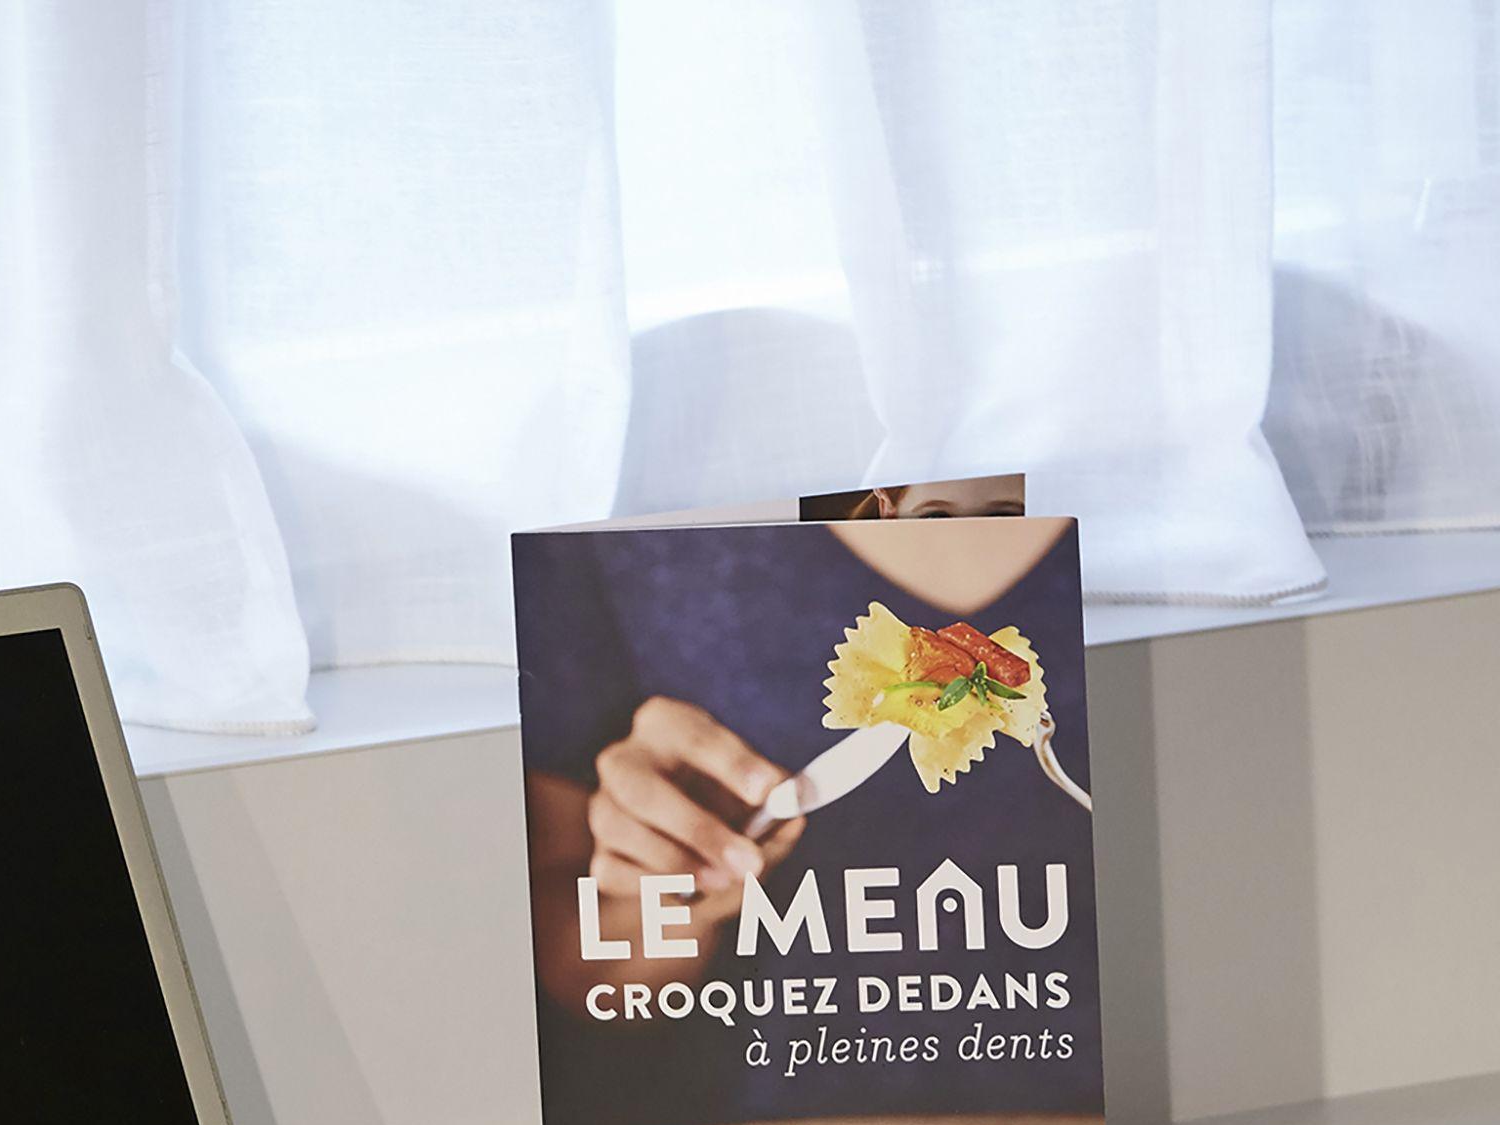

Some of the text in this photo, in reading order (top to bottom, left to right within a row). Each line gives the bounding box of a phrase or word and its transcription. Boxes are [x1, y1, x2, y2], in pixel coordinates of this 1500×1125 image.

[577, 873, 698, 961] LE
[585, 971, 1071, 1027] CROQUEZ DEDANS
[745, 1022, 1075, 1078] à pleines dents
